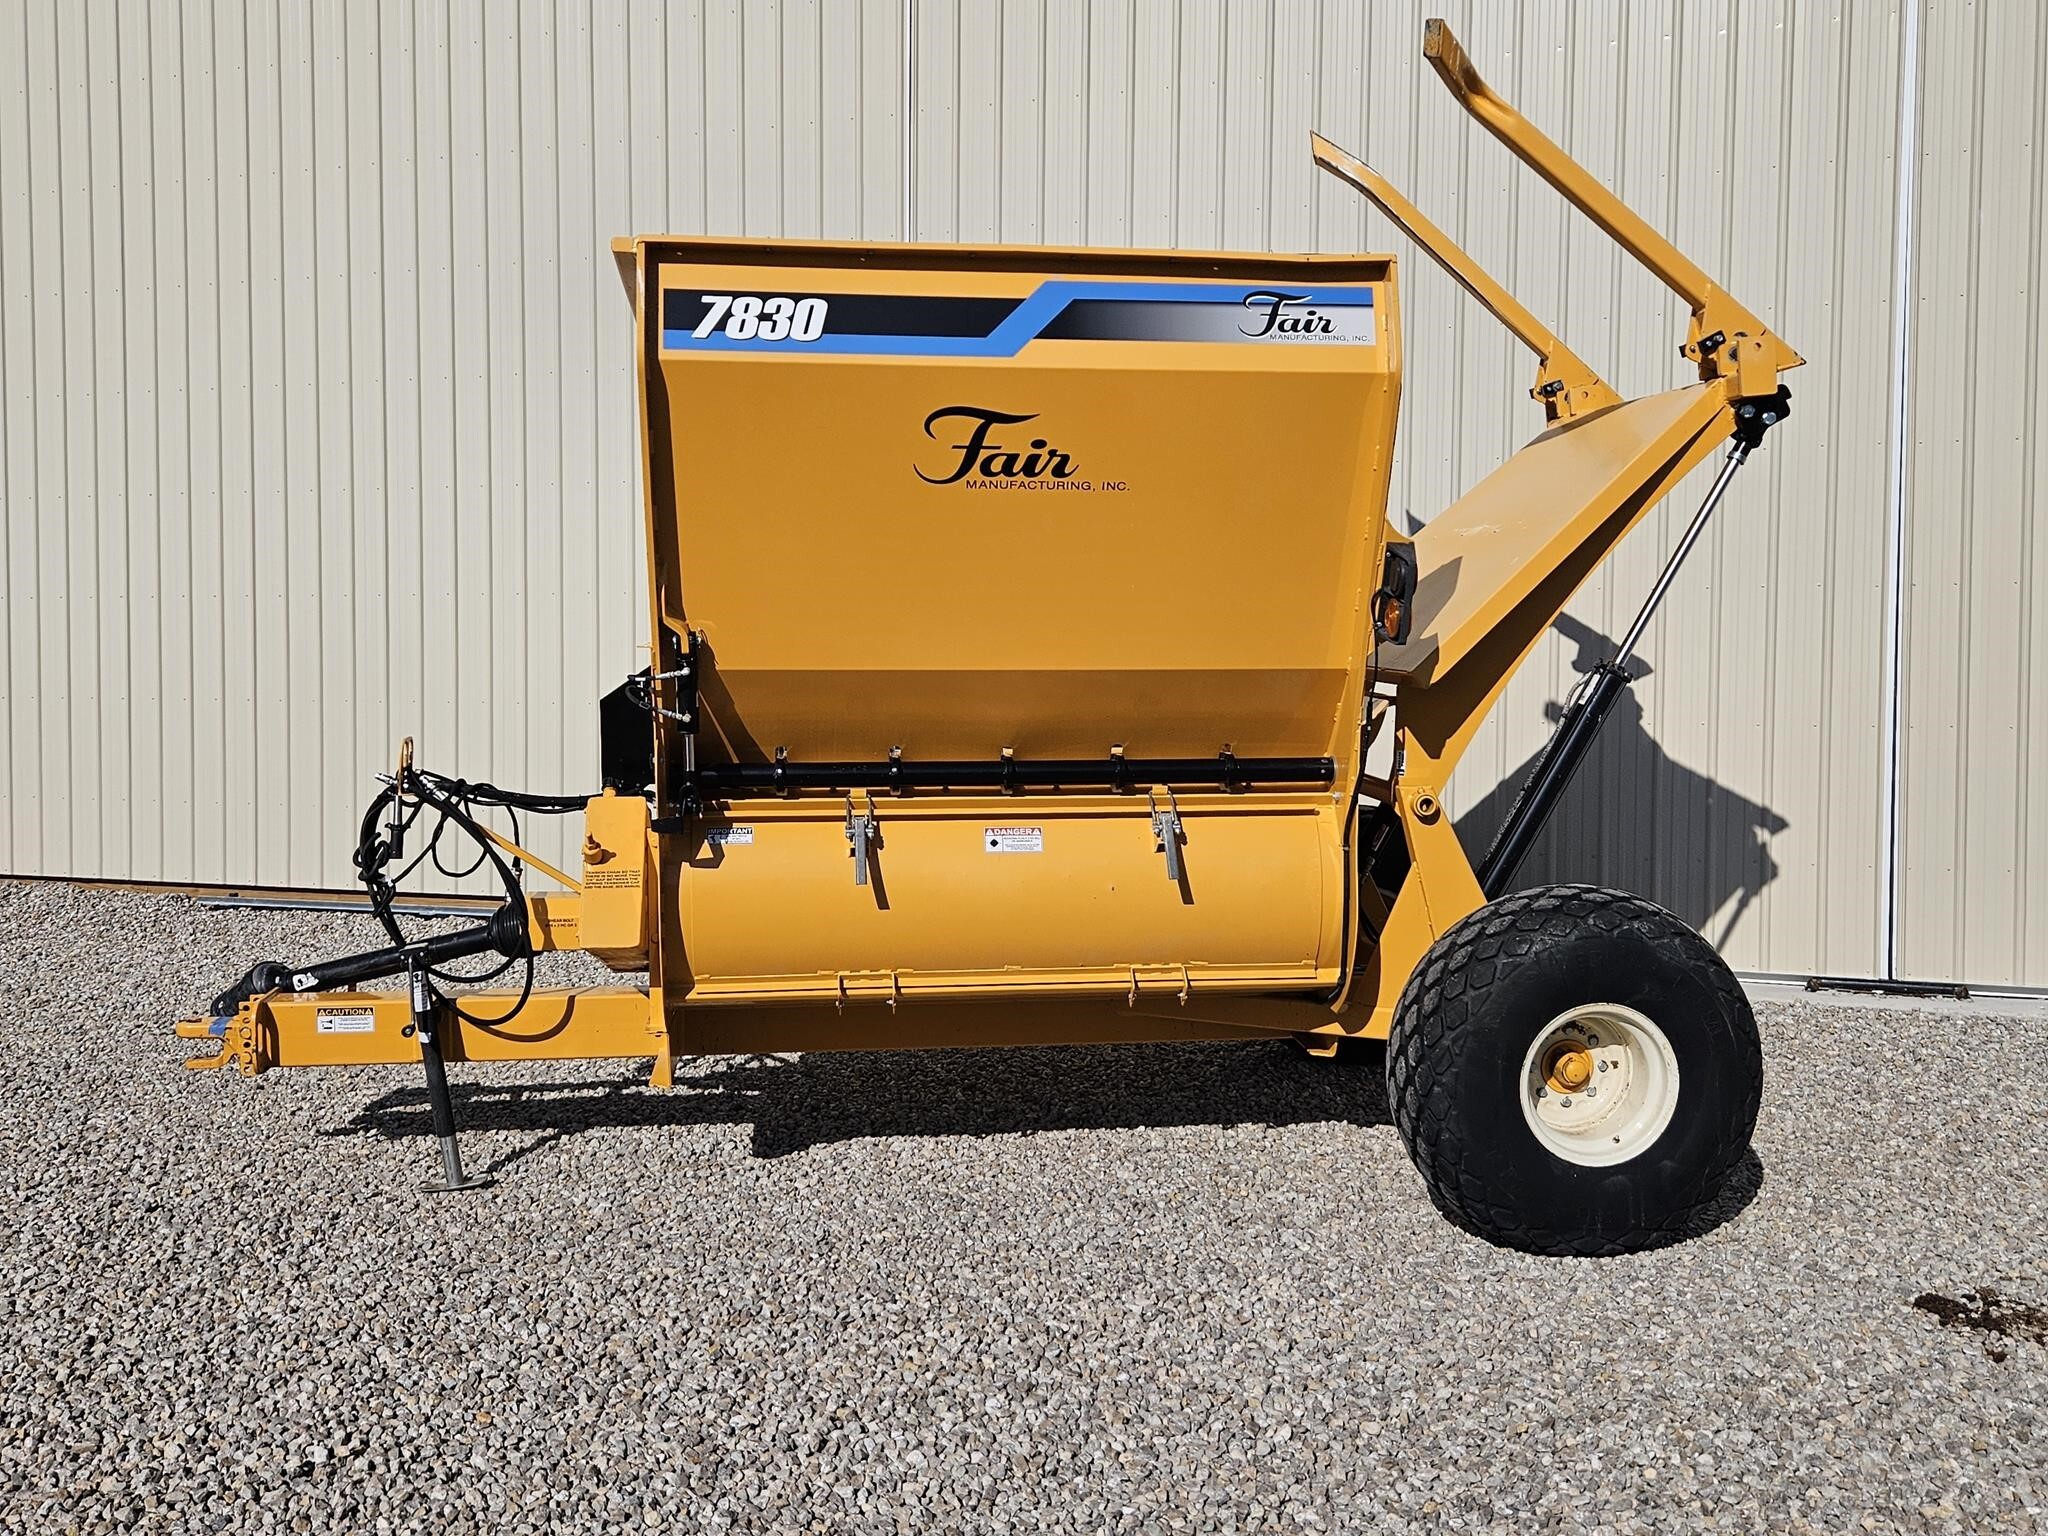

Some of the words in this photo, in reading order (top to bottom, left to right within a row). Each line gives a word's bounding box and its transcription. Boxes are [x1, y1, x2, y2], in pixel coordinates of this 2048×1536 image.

[691, 295, 829, 342] 7830
[1238, 290, 1338, 337] Fair
[1269, 334, 1349, 342] MANUFACTURING,
[913, 406, 1080, 485] Fair
[966, 479, 1096, 492] MANUFACTURING,
[1101, 481, 1131, 491] INC.
[325, 1008, 365, 1016] CAUTION
